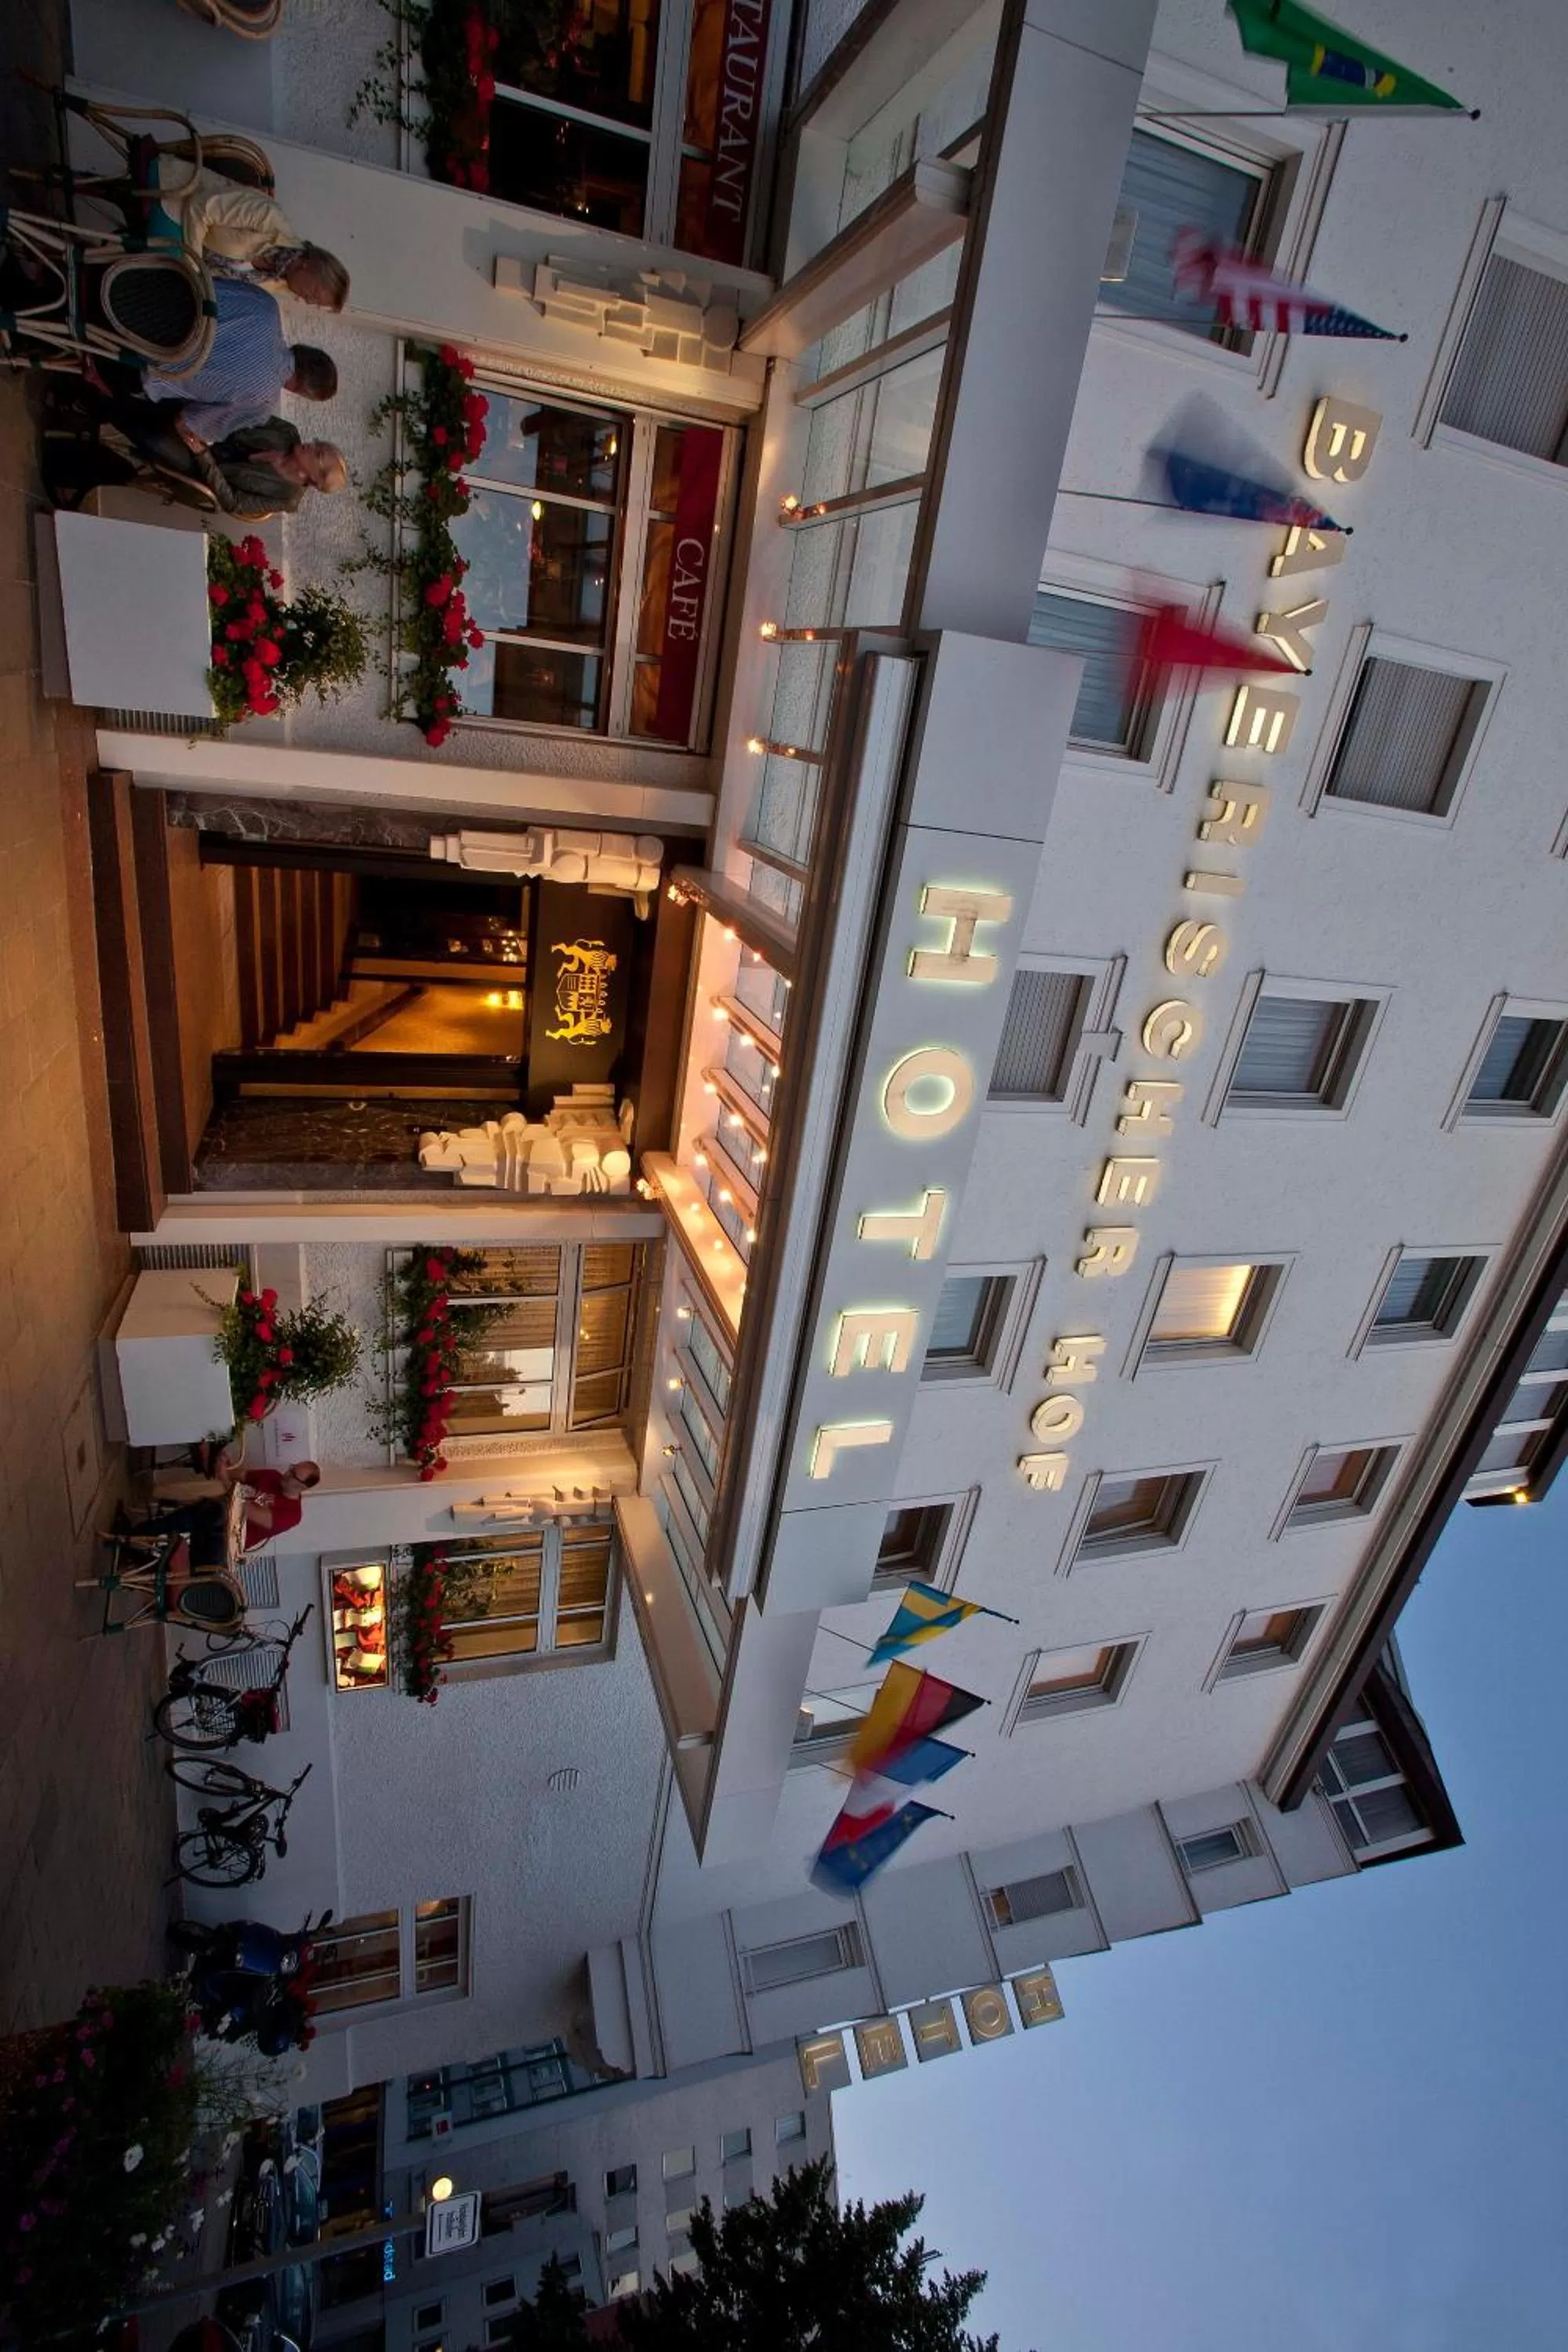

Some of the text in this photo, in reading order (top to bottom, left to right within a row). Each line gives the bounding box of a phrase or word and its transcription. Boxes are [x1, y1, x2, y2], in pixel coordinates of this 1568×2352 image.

[667, 538, 705, 641] CAFÉ
[1018, 396, 1384, 1491] BAYERISCHER HOF
[808, 886, 1012, 1479] HOTEL
[803, 1976, 1060, 2089] HOTEL
